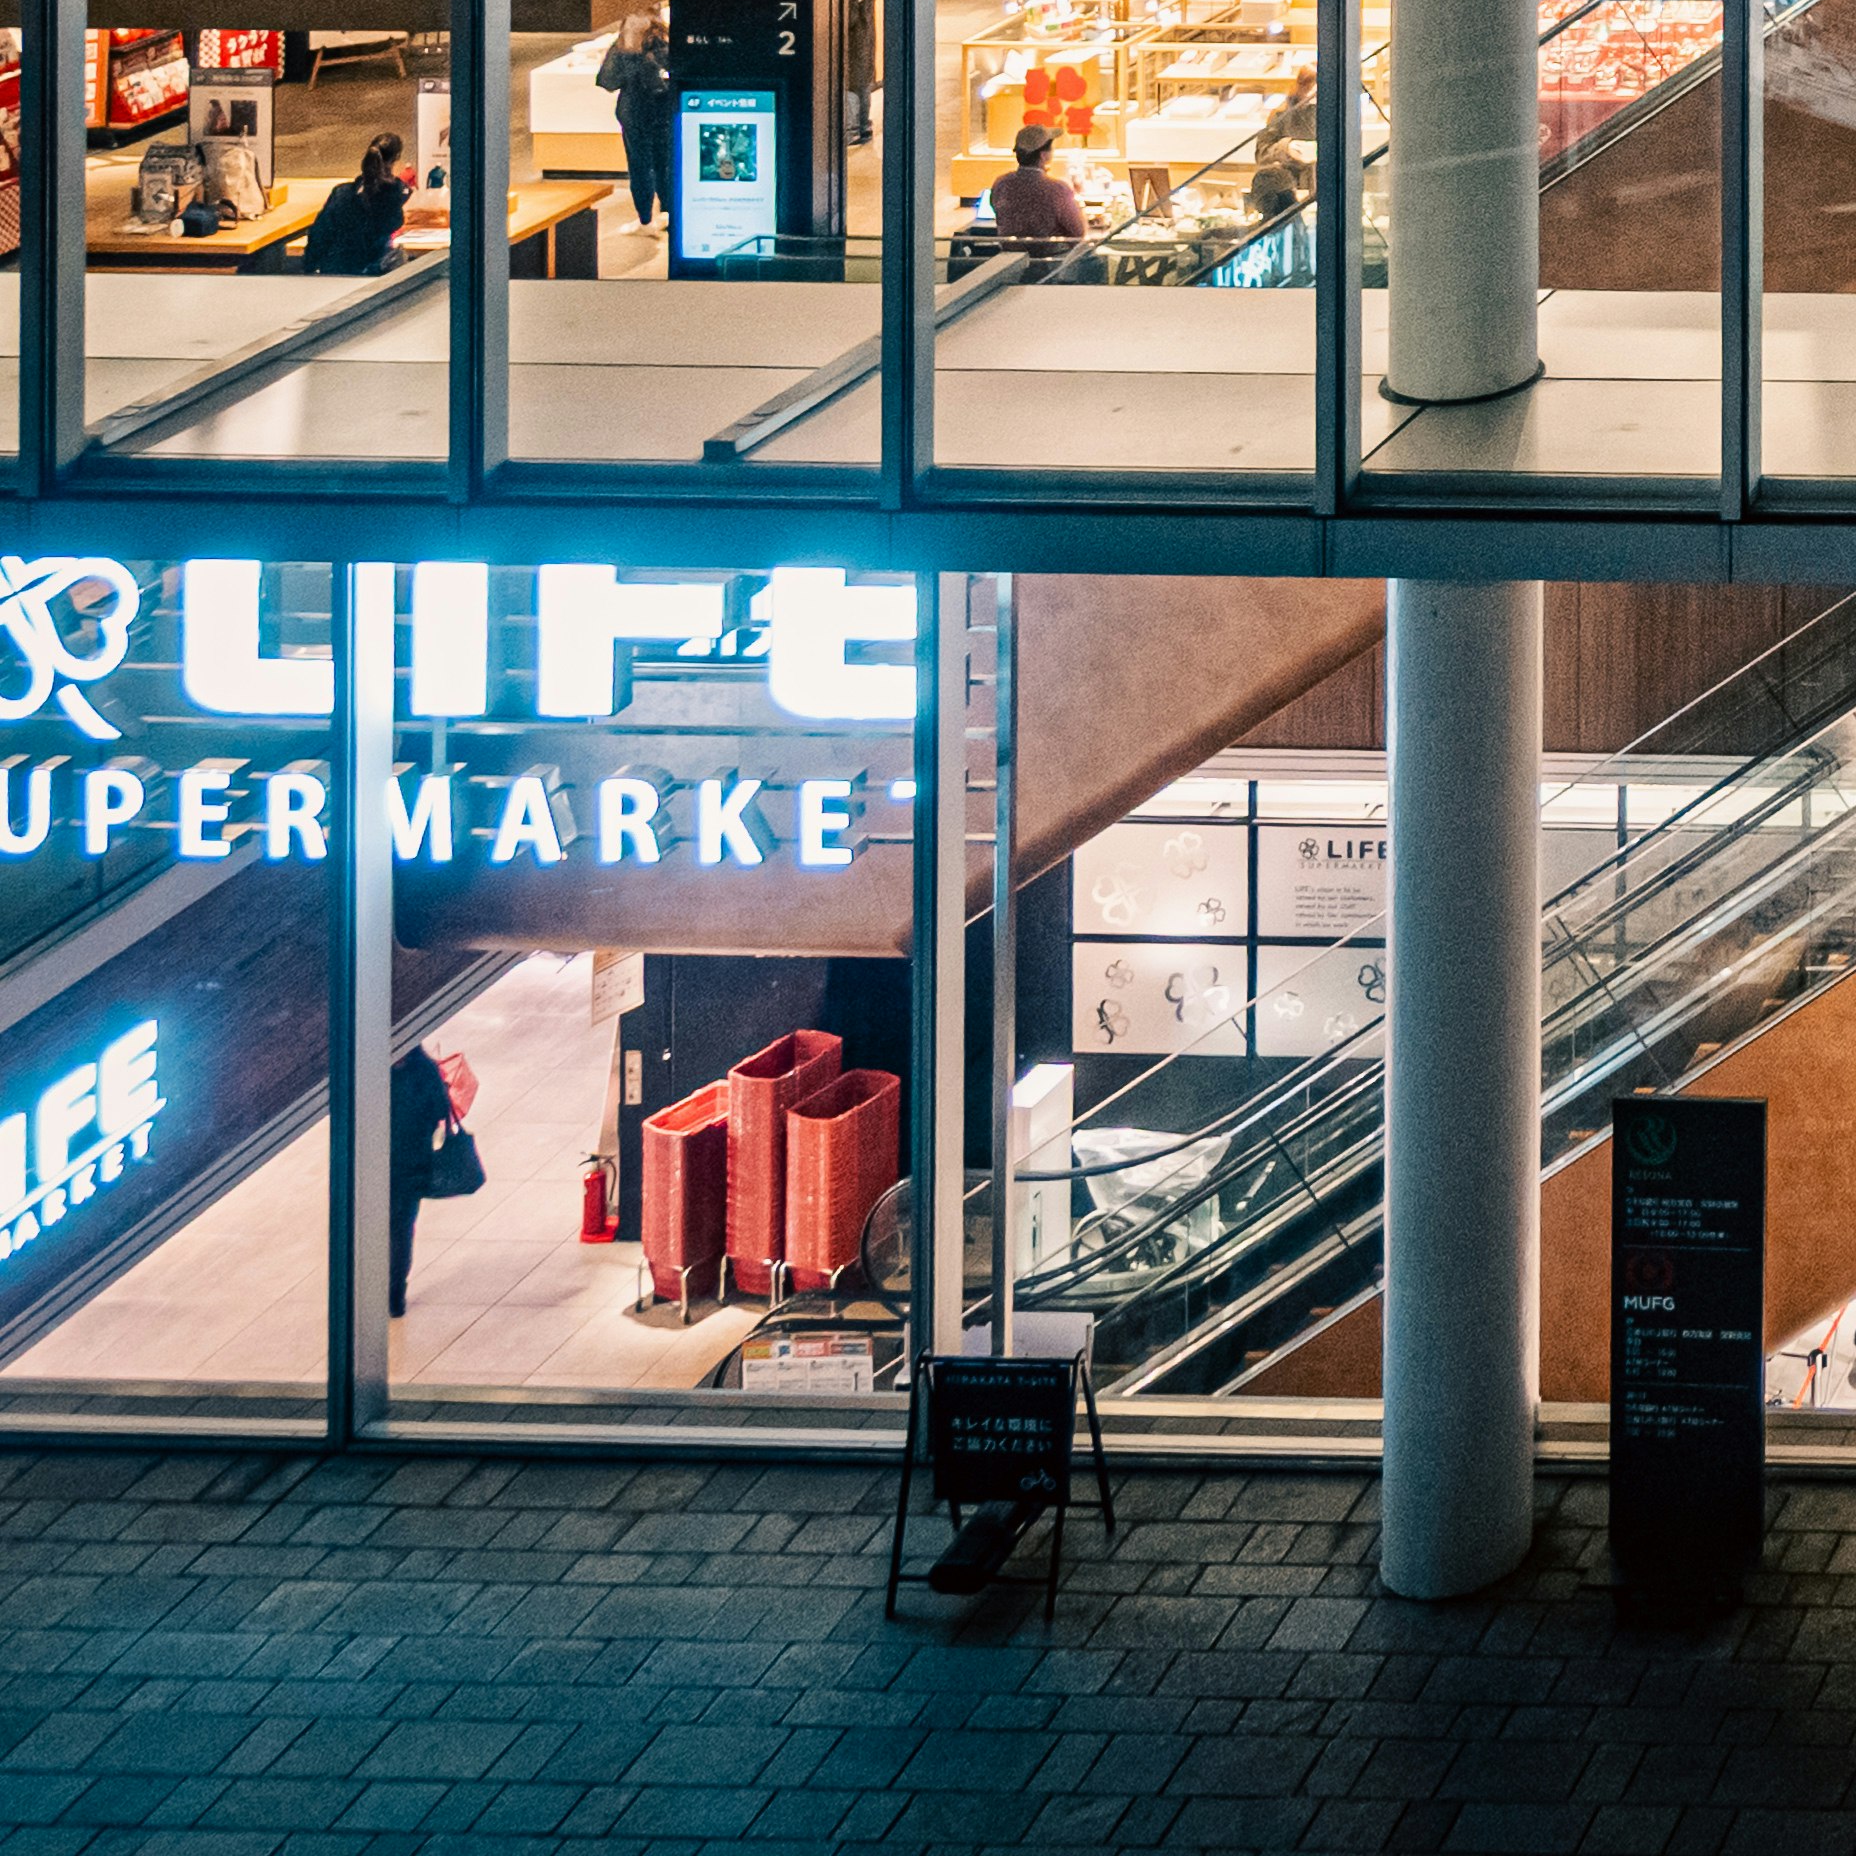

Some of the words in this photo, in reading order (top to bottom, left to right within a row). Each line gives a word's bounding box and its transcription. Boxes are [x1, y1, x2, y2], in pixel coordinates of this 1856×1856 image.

[777, 30, 797, 56] 2
[184, 560, 917, 720] LIFE
[0, 768, 917, 866] UPERMARKE
[1327, 840, 1387, 860] LIFE
[0, 1018, 160, 1208] IFE
[1623, 1295, 1676, 1312] MUFG
[945, 1375, 1012, 1387] HIRAKATA
[949, 1416, 1055, 1434] キレイな環境に
[951, 1435, 1054, 1454] ご協力ください
